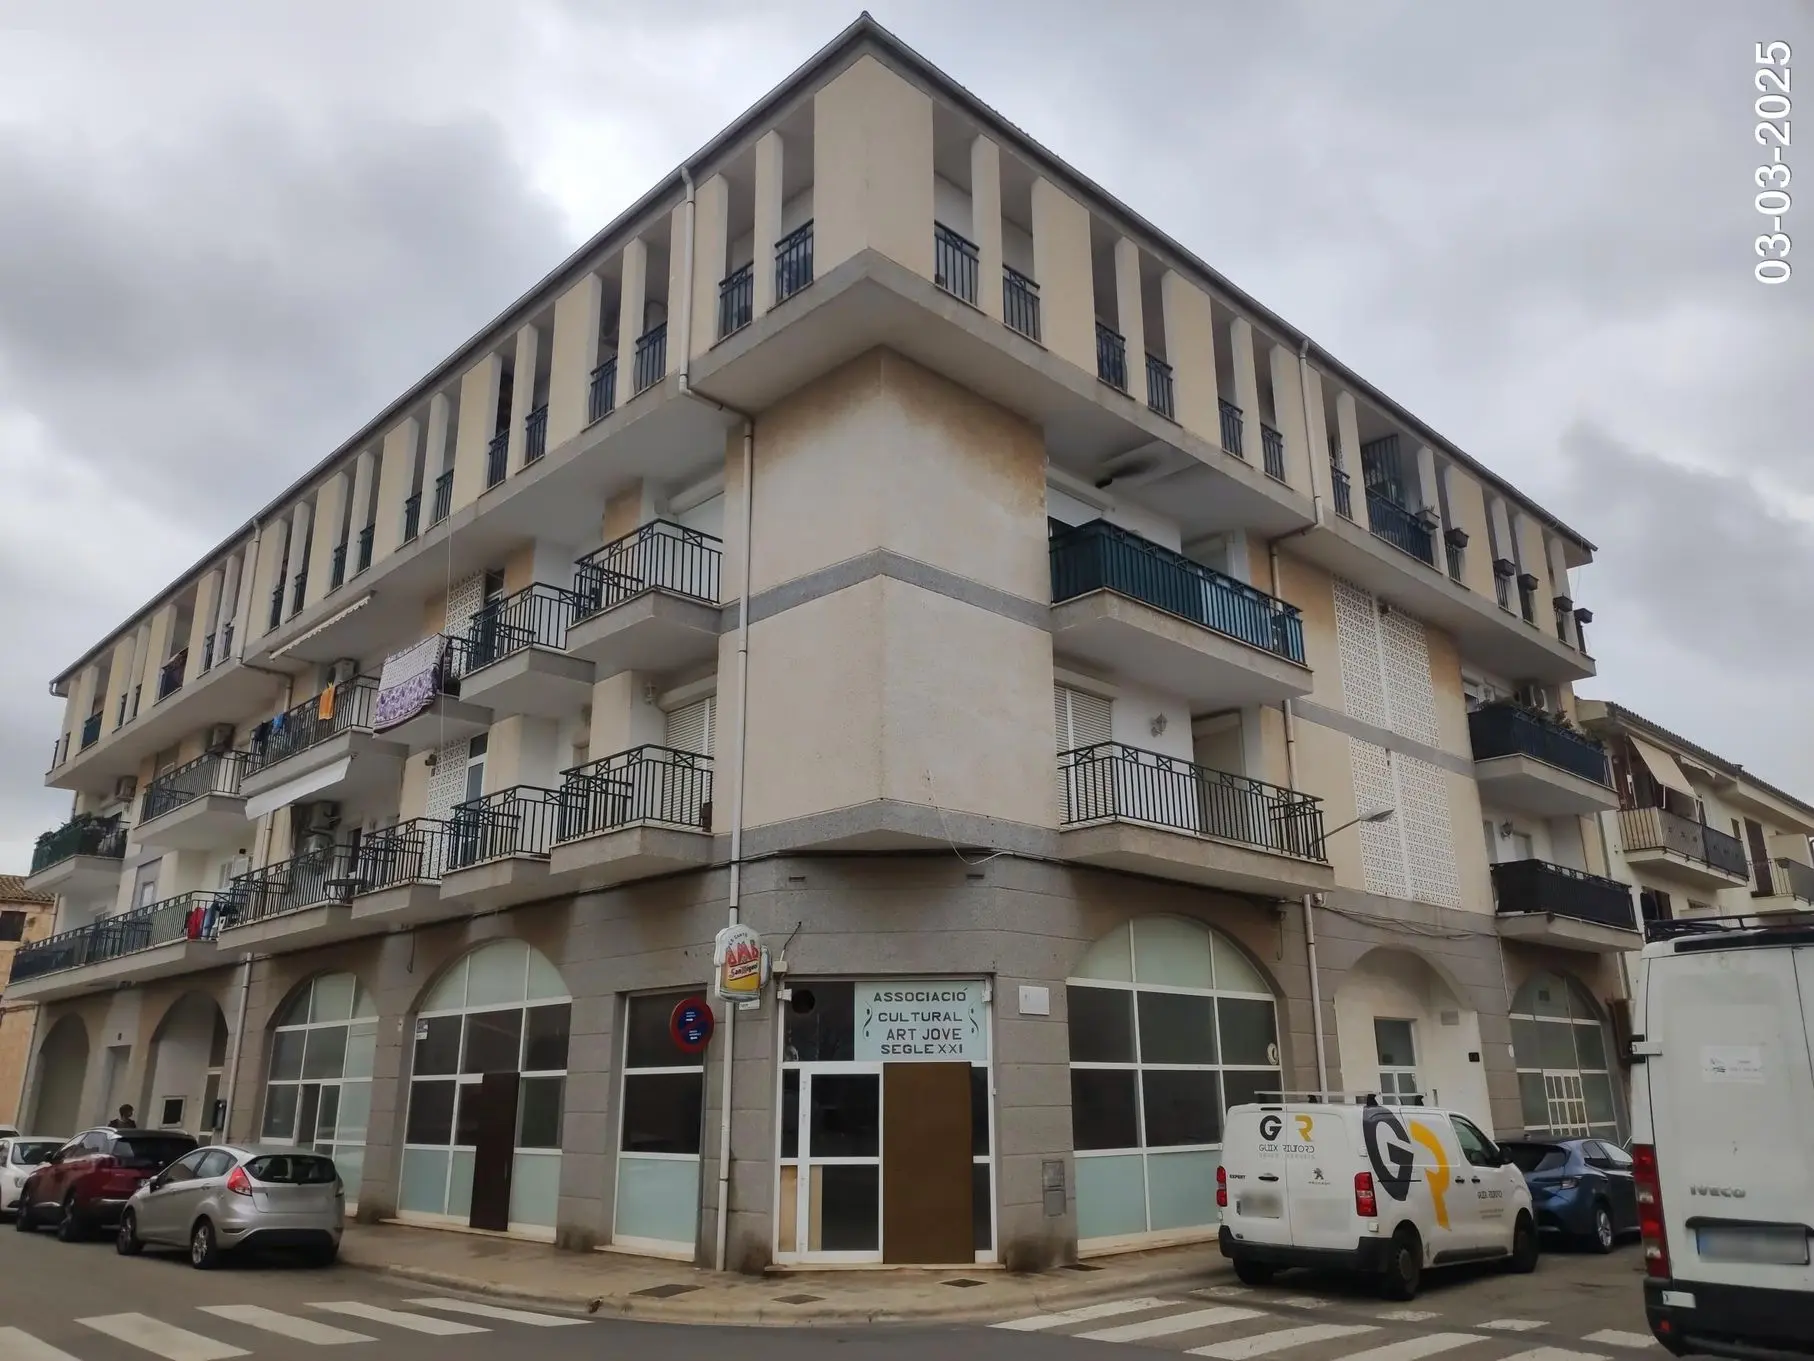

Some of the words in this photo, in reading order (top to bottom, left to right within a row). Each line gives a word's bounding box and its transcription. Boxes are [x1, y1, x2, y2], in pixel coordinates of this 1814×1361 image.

[873, 987, 968, 1002] ASSOCIACIÓ
[878, 1011, 963, 1022] CULTURAL
[886, 1028, 917, 1041] ART
[922, 1028, 962, 1041] JOVE
[880, 1043, 934, 1055] SEGLE
[938, 1043, 963, 1054] XXI
[1689, 1185, 1747, 1199] IVECO
